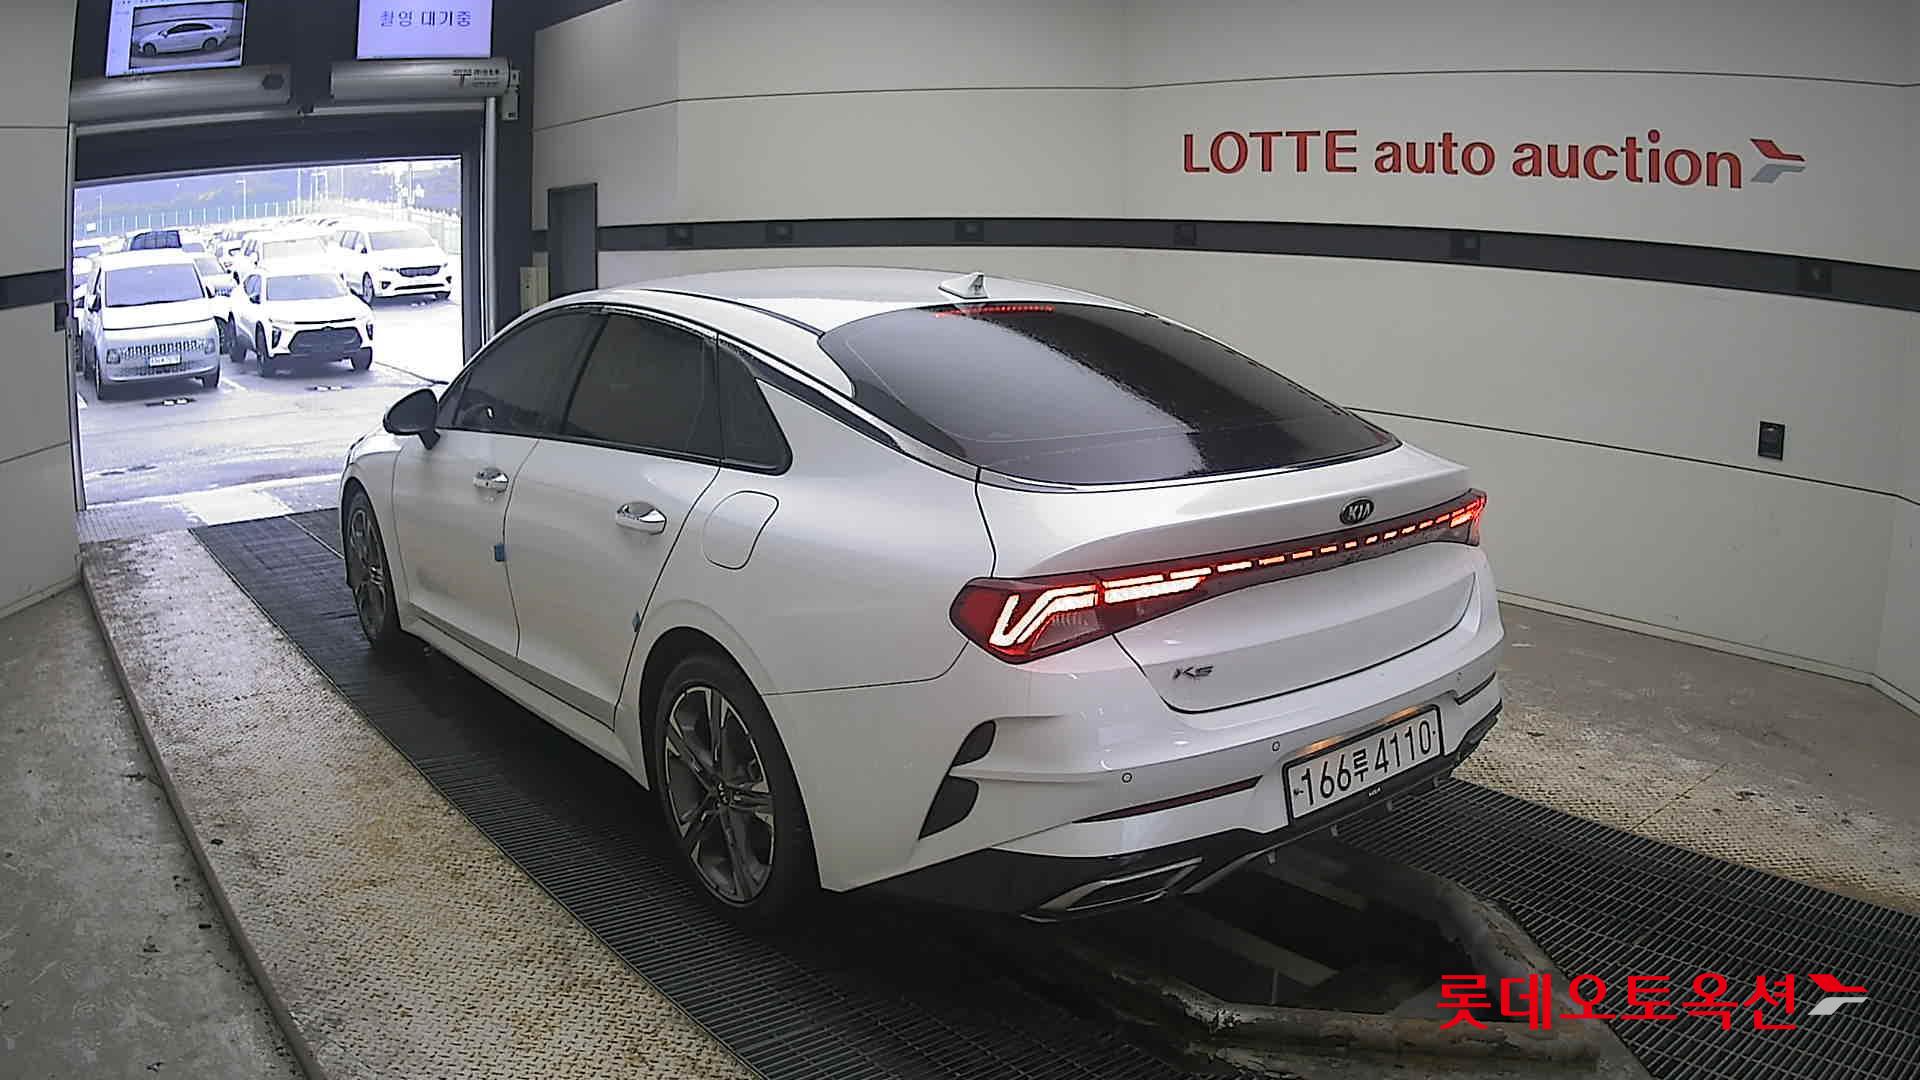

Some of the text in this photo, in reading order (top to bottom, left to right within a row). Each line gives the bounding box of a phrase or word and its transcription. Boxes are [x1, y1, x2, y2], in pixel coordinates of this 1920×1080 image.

[421, 10, 471, 27] 대기중
[1184, 129, 1742, 189] LOTTE auto auction
[1347, 502, 1371, 521] KIA
[1173, 665, 1214, 680] K5
[1301, 720, 1431, 806] 166루 4110
